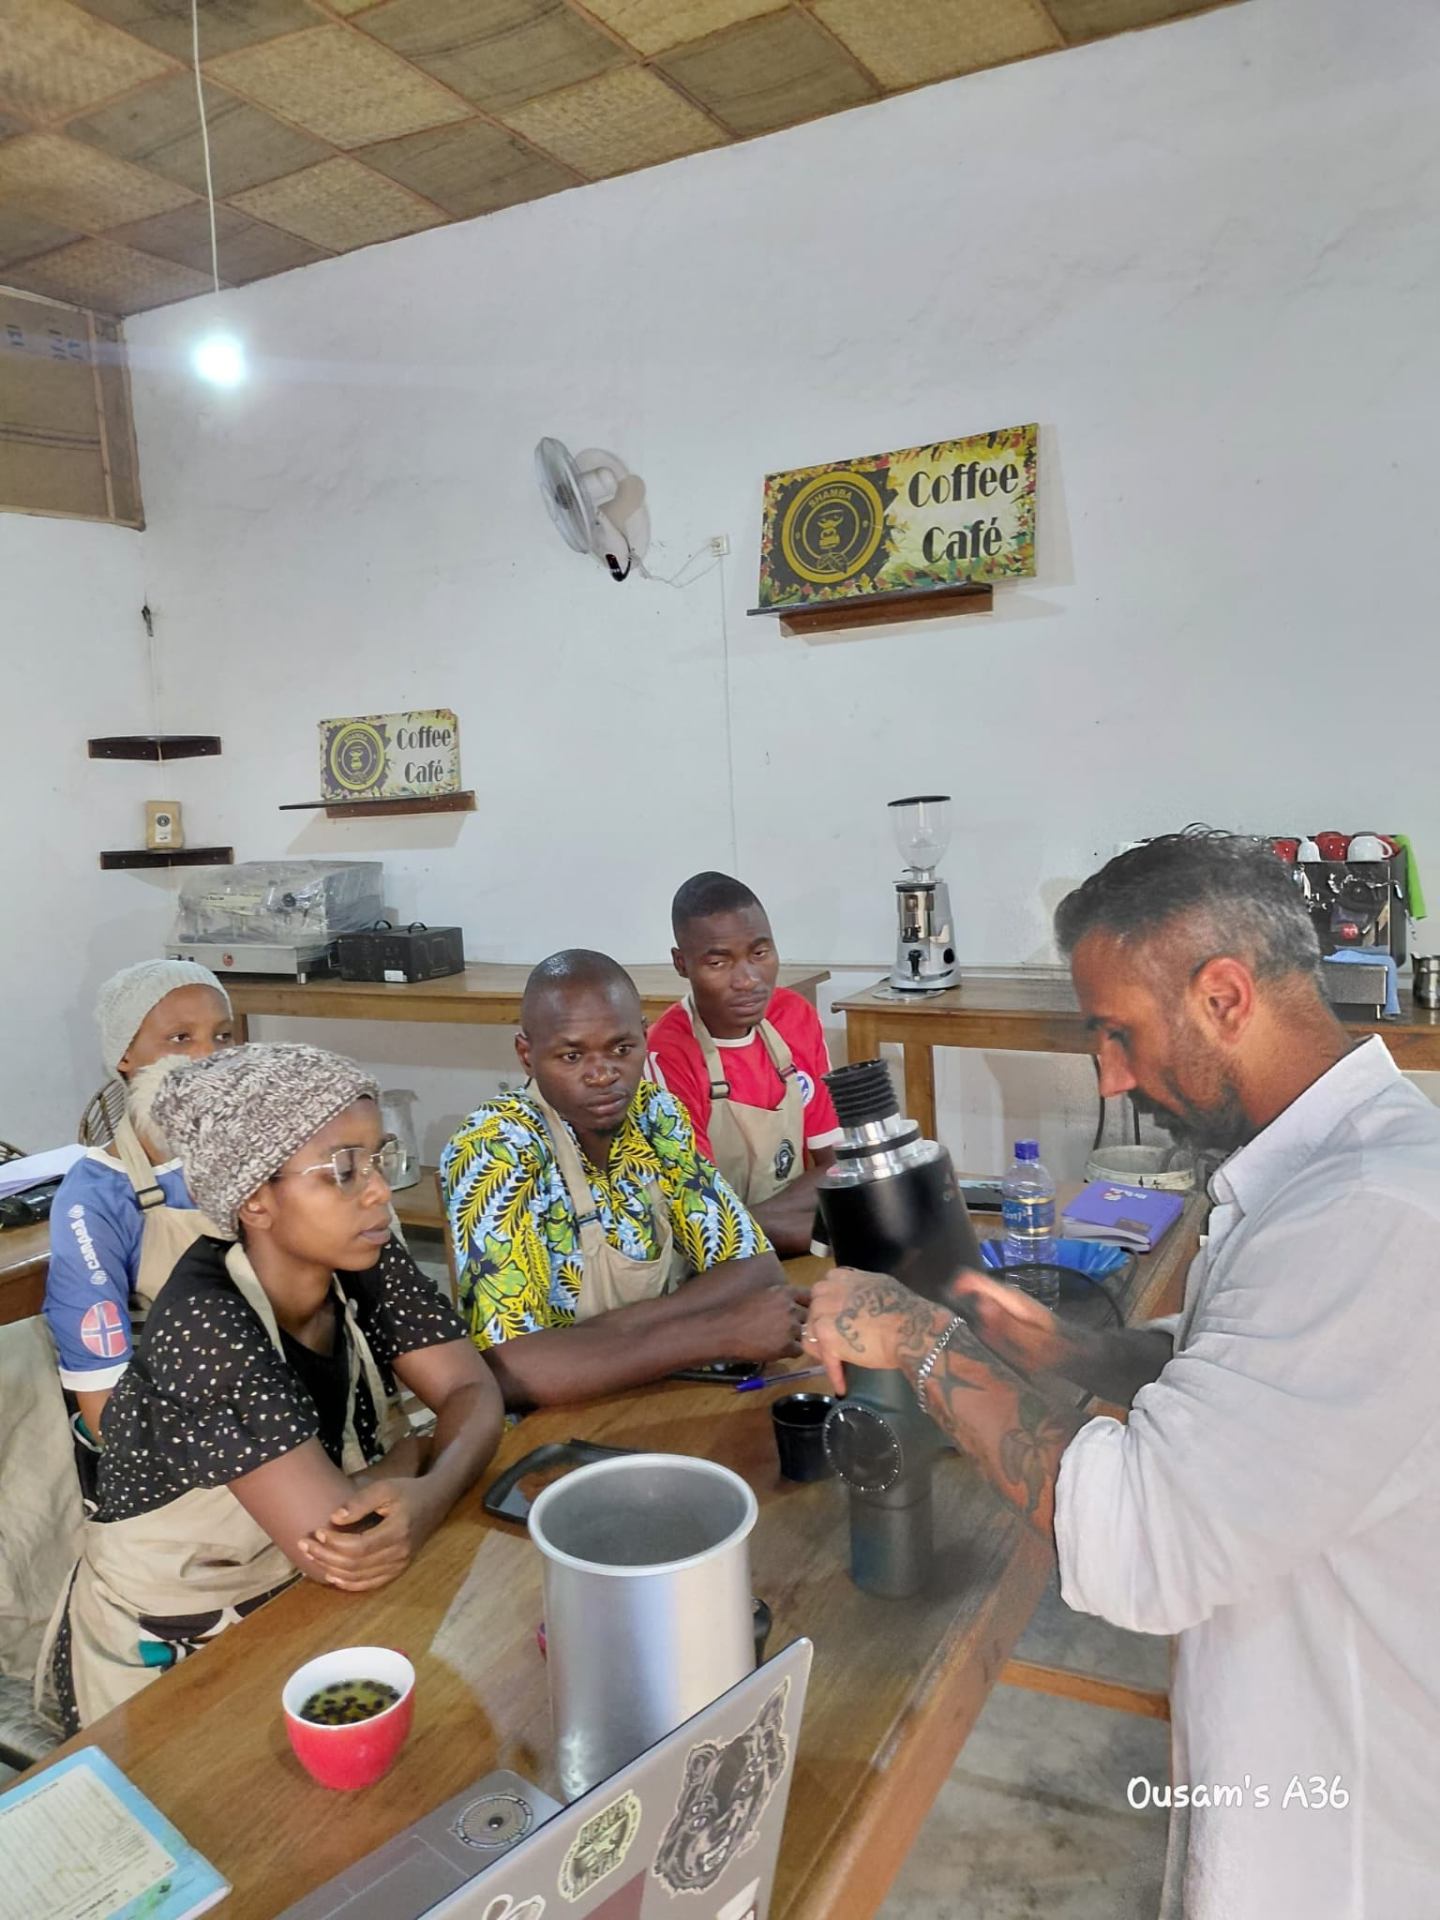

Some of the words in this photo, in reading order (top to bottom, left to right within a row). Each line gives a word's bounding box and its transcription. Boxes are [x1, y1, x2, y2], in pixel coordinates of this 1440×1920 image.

[908, 461, 1019, 508] Coffee
[922, 516, 1003, 564] Café
[396, 725, 452, 750] Coffee
[404, 759, 444, 784] Café
